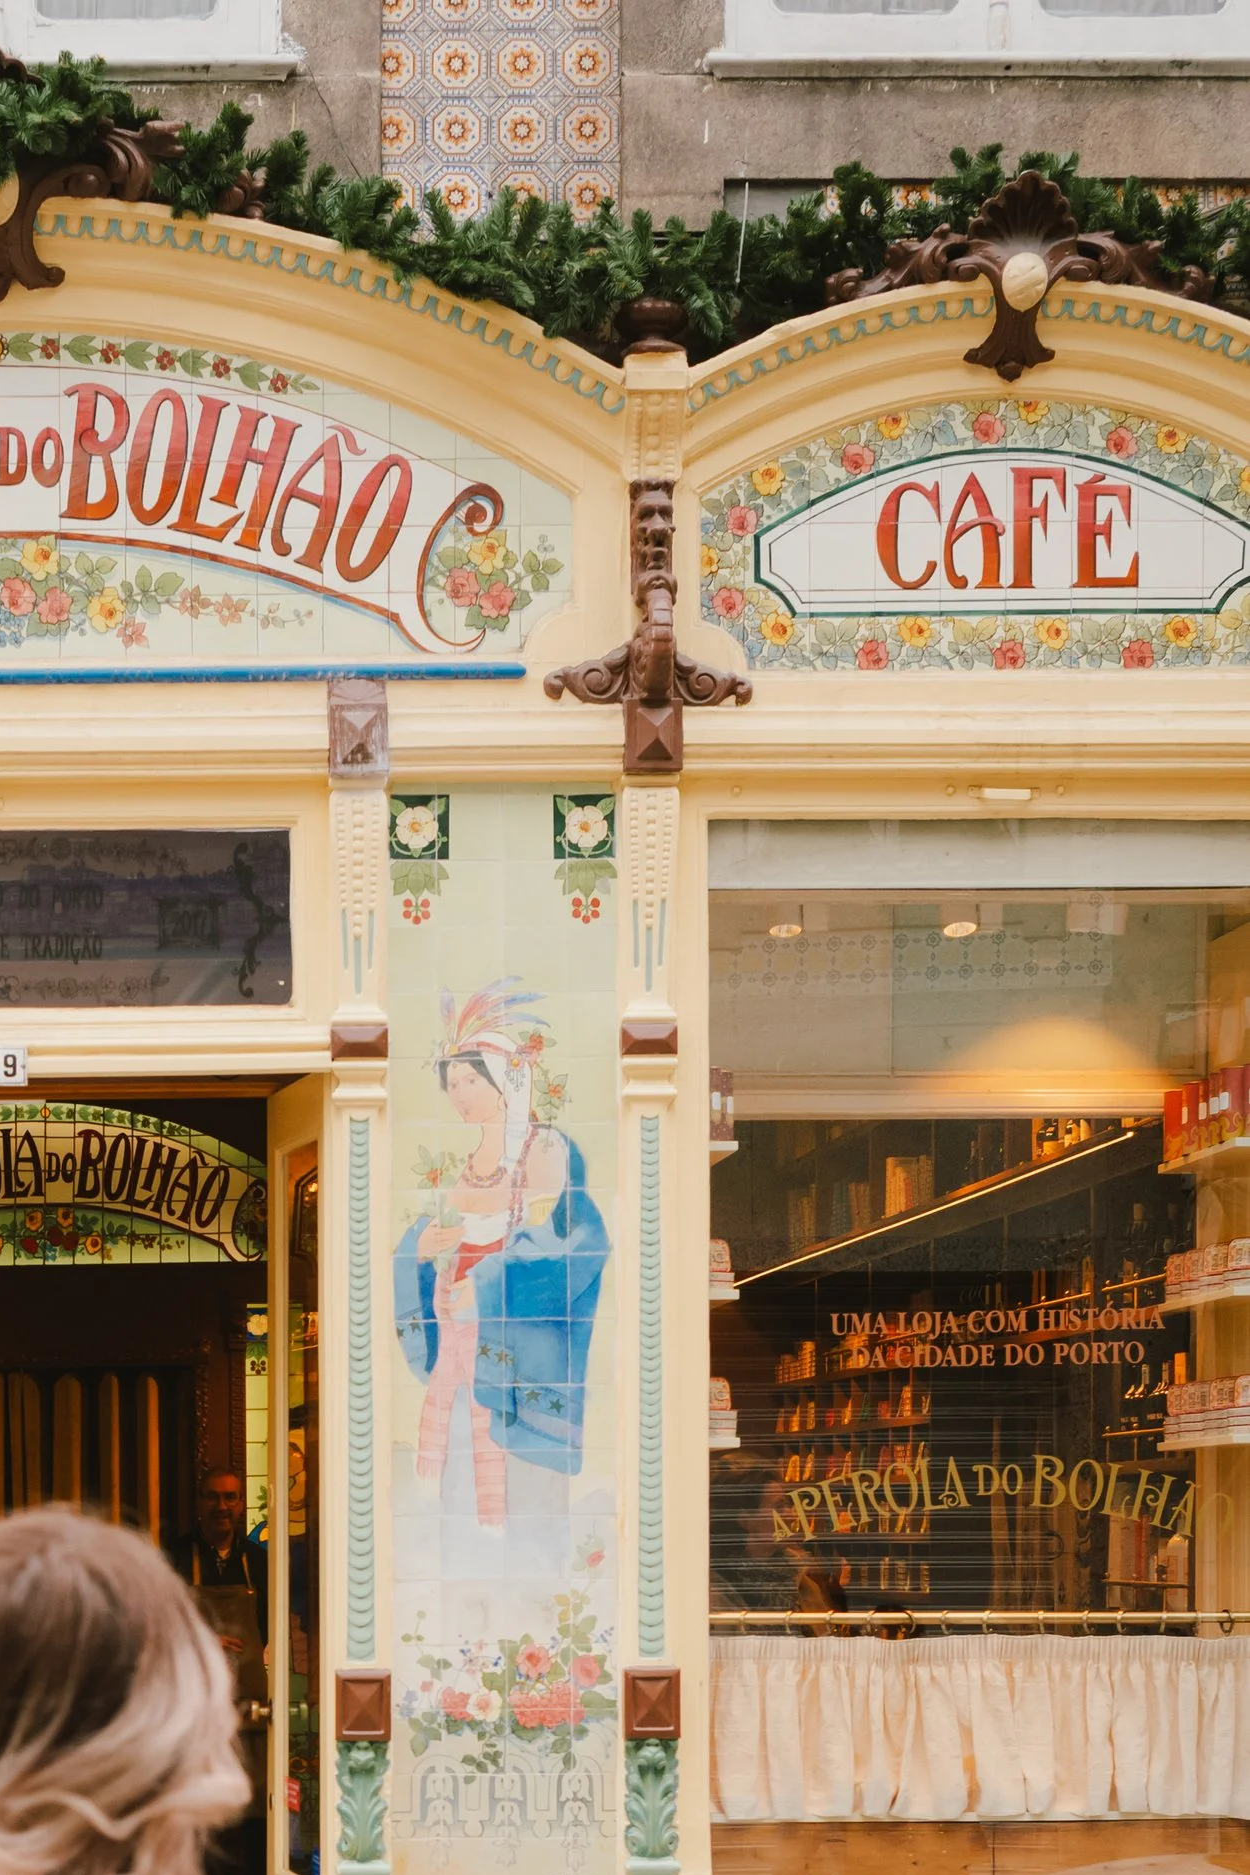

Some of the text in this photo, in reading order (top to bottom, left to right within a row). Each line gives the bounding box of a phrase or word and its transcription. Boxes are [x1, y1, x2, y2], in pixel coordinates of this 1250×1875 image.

[60, 382, 413, 582] BOLHÃO
[876, 466, 1139, 590] CAFÉ
[19, 884, 41, 907] DO
[52, 884, 104, 908] PORTO
[20, 927, 104, 965] TRADIÇÃO
[44, 1152, 76, 1184] DO
[75, 1128, 231, 1229] BOLHÃO
[830, 1301, 1166, 1340] UMA LOJA COM HISTÓRIA
[851, 1340, 1145, 1369] DA CIDADE DO PORTO
[771, 1507, 794, 1542] A
[972, 1464, 1025, 1496] DO
